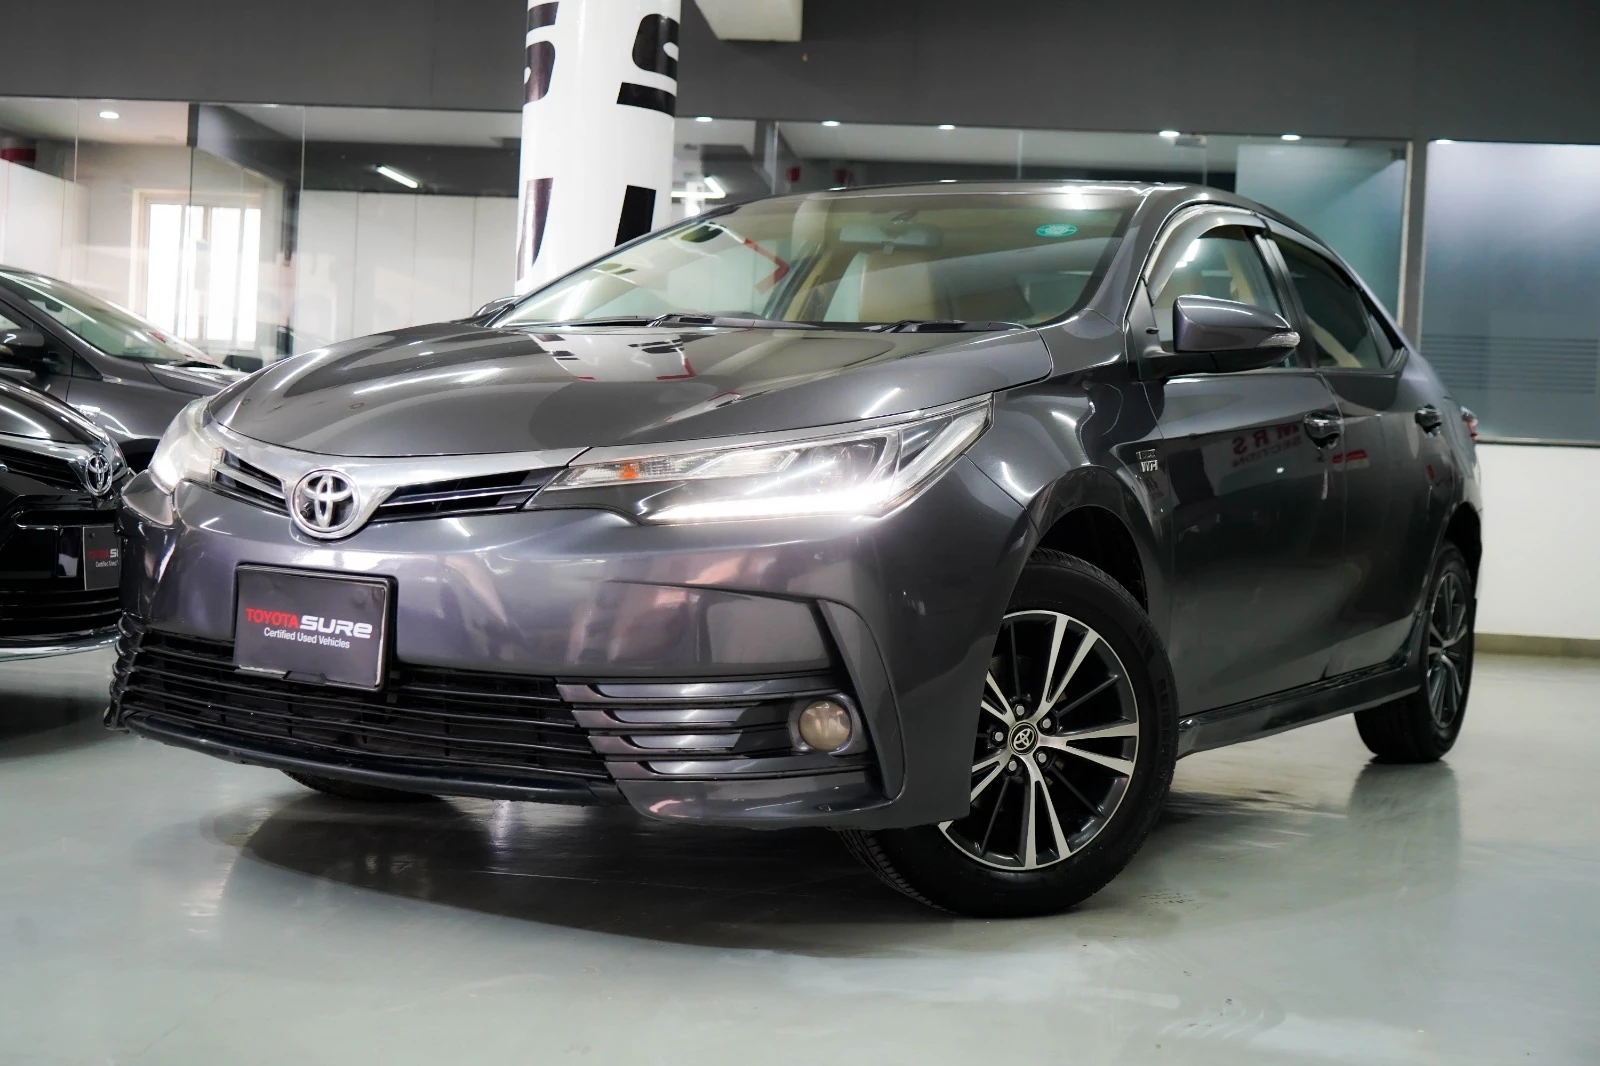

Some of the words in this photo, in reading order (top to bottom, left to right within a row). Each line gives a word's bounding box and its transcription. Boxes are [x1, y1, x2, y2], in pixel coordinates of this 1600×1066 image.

[245, 607, 299, 629] TOYOTA
[264, 627, 296, 642] Certified
[297, 632, 317, 644] Used
[318, 636, 351, 649] Vehicles
